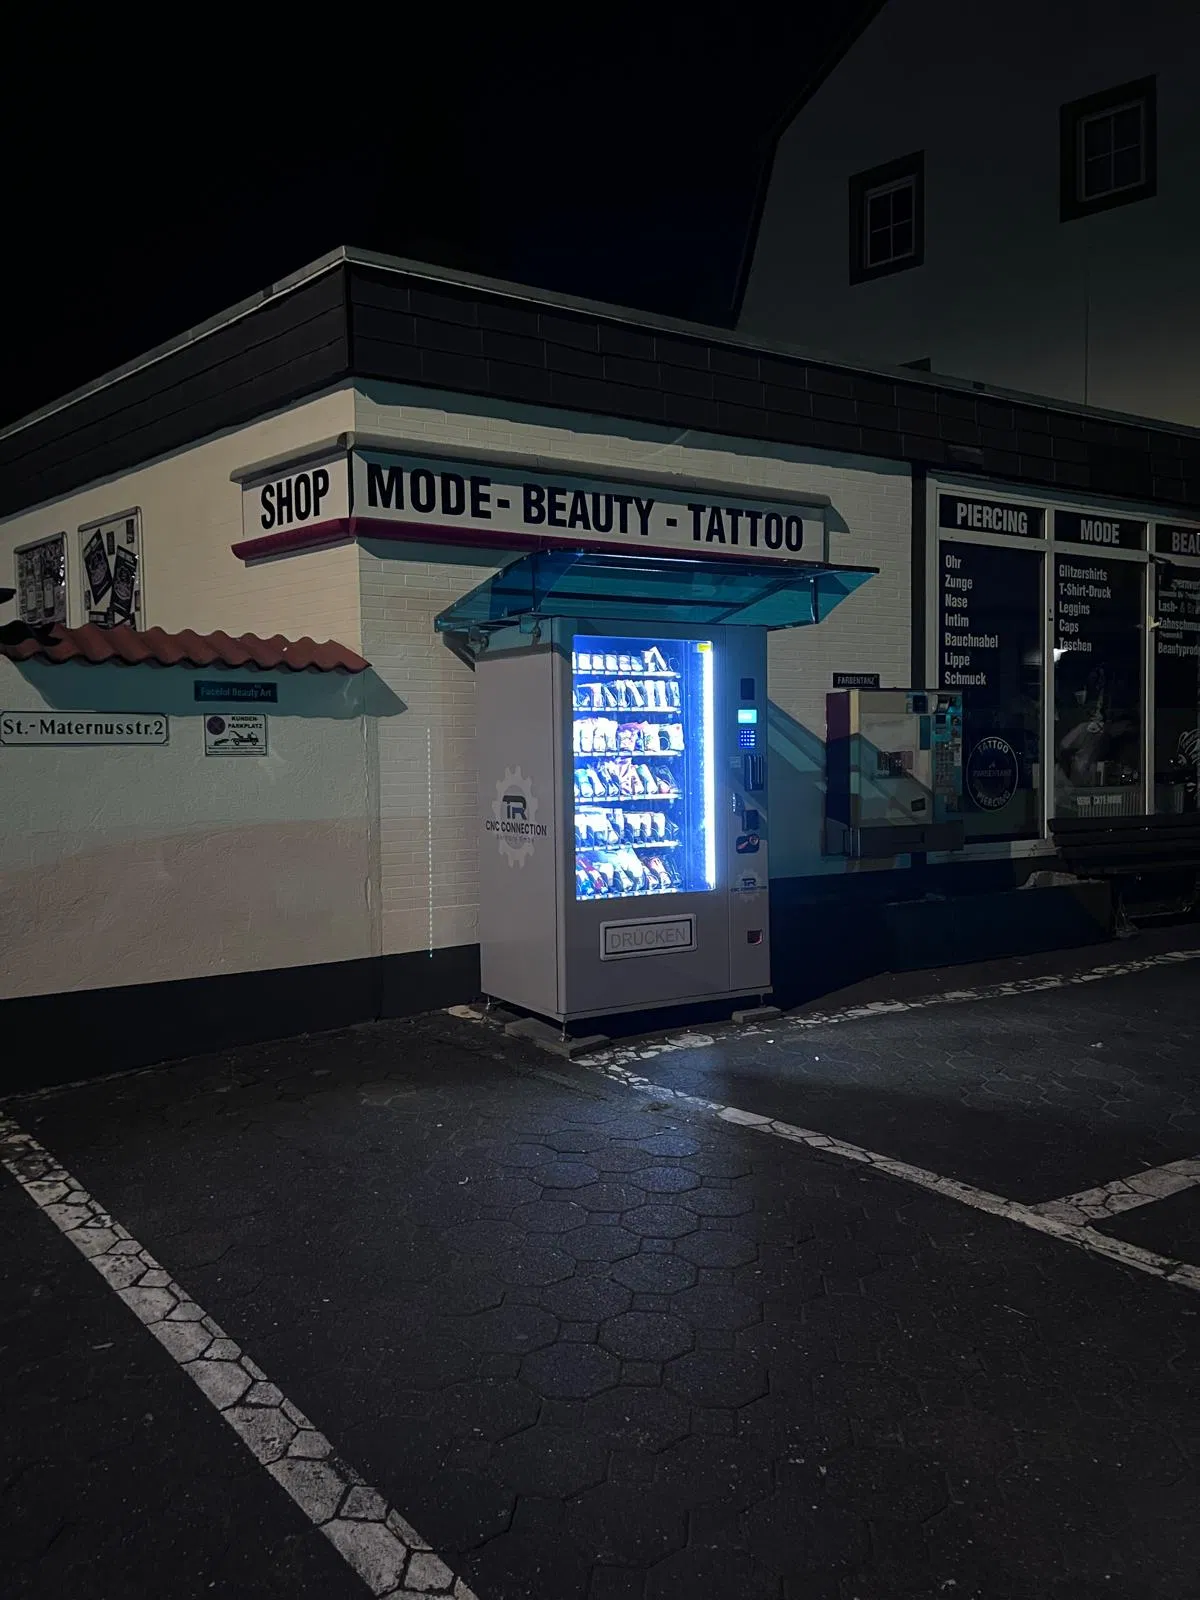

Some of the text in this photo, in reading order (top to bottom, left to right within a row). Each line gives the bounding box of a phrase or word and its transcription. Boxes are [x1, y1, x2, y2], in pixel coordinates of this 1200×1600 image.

[261, 468, 329, 530] SHOP
[523, 483, 655, 536] BEAUTY
[687, 503, 803, 552] TATTOO
[956, 502, 1028, 535] PIERCING
[1080, 519, 1120, 545] MODE
[945, 554, 962, 569] Ohr
[1059, 564, 1108, 581] Glitzershirts
[945, 574, 973, 591] Zunge
[1059, 582, 1112, 599] T-Shirt-Druck
[945, 593, 968, 608] Nase
[1059, 601, 1090, 617] Leggins
[945, 612, 969, 628] Intim
[1059, 619, 1079, 635] Caps
[945, 632, 999, 648] Bauchnabel
[1059, 637, 1092, 652] Taschen
[945, 652, 970, 668] Lippe
[945, 671, 987, 686] Schmuck
[977, 739, 1009, 755] TATTOO
[485, 820, 547, 836] CNC CONNECTION
[611, 927, 686, 949] DRÜCKEN
